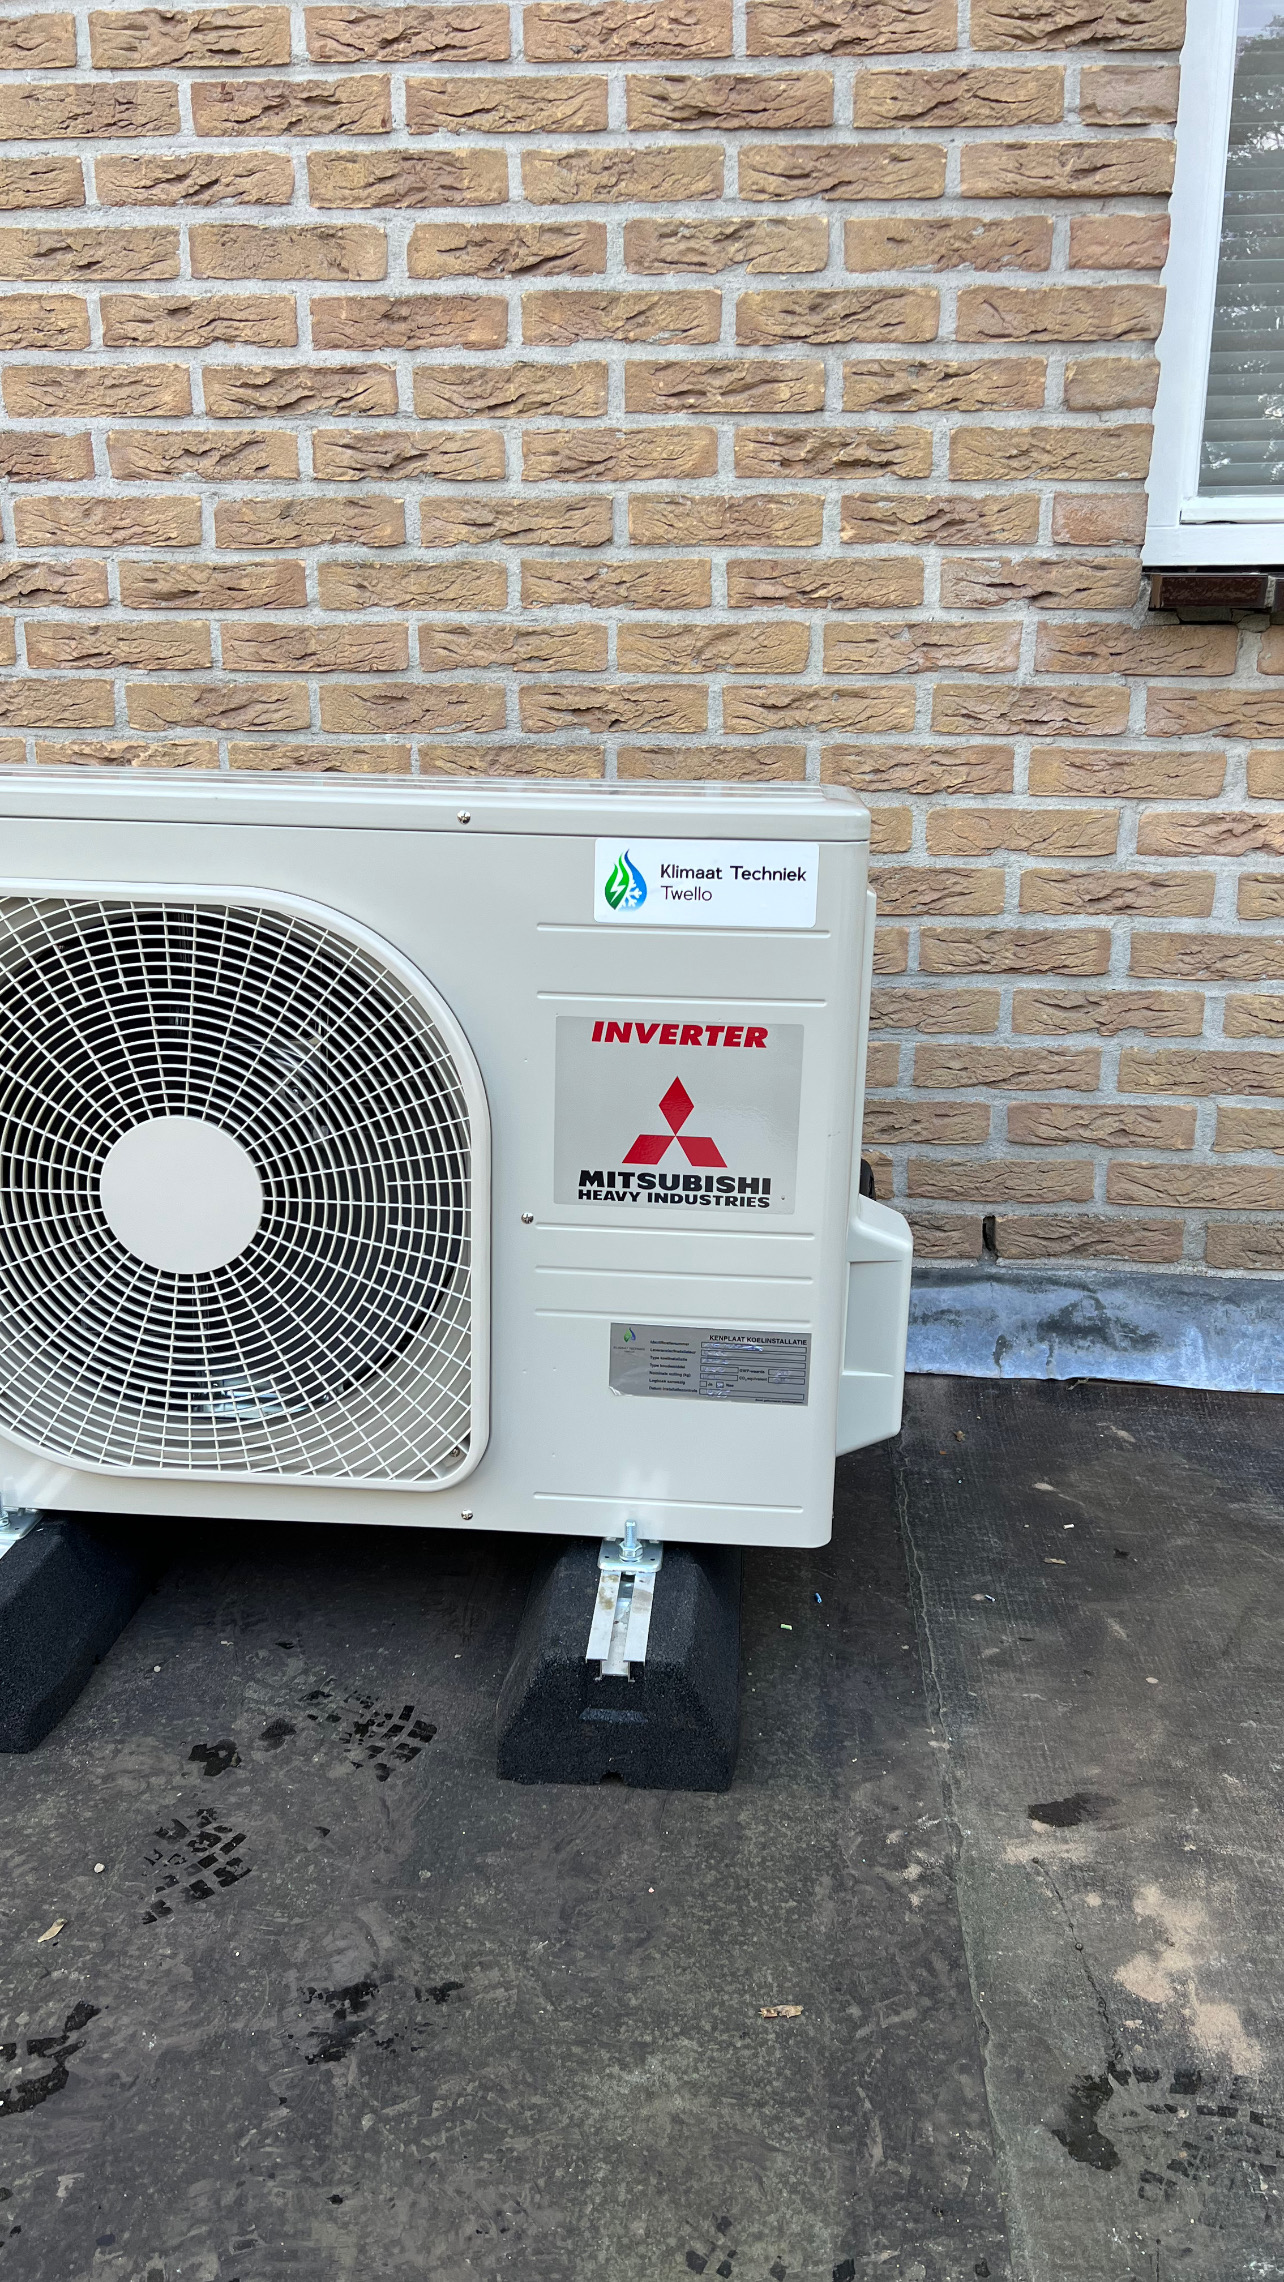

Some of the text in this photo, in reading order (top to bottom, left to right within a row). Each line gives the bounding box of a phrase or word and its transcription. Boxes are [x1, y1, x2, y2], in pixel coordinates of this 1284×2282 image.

[660, 863, 807, 882] Klimaat Techniek
[660, 885, 713, 902] Twello
[591, 1020, 769, 1049] INVERTER
[578, 1169, 771, 1195] MITSUBISHI
[578, 1189, 770, 1208] HEAVY INDUSTRIES
[709, 1334, 808, 1346] KENPLAAT KOELINSTALLATIE
